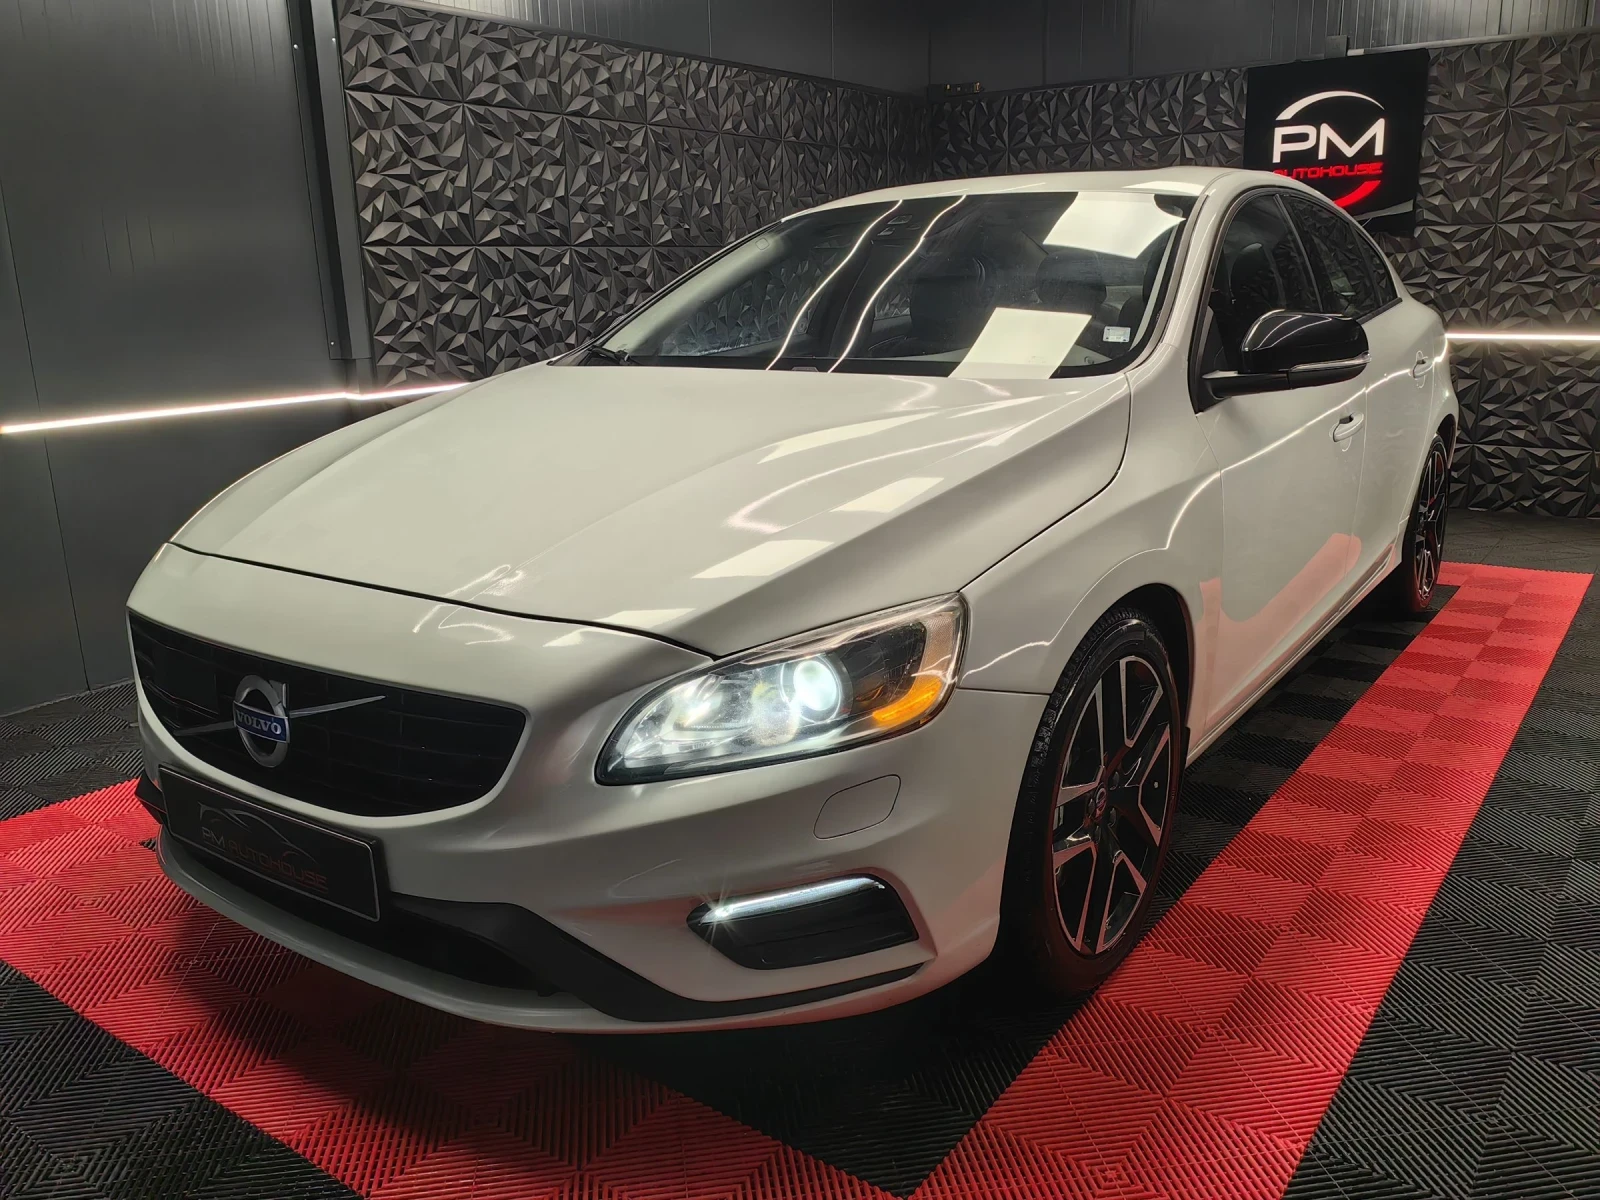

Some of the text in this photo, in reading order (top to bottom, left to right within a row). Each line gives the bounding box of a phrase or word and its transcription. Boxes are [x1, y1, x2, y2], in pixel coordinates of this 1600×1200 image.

[1272, 118, 1385, 163] PM
[236, 709, 282, 735] VOLVO
[201, 826, 328, 886] PM AUTOHOUSE
